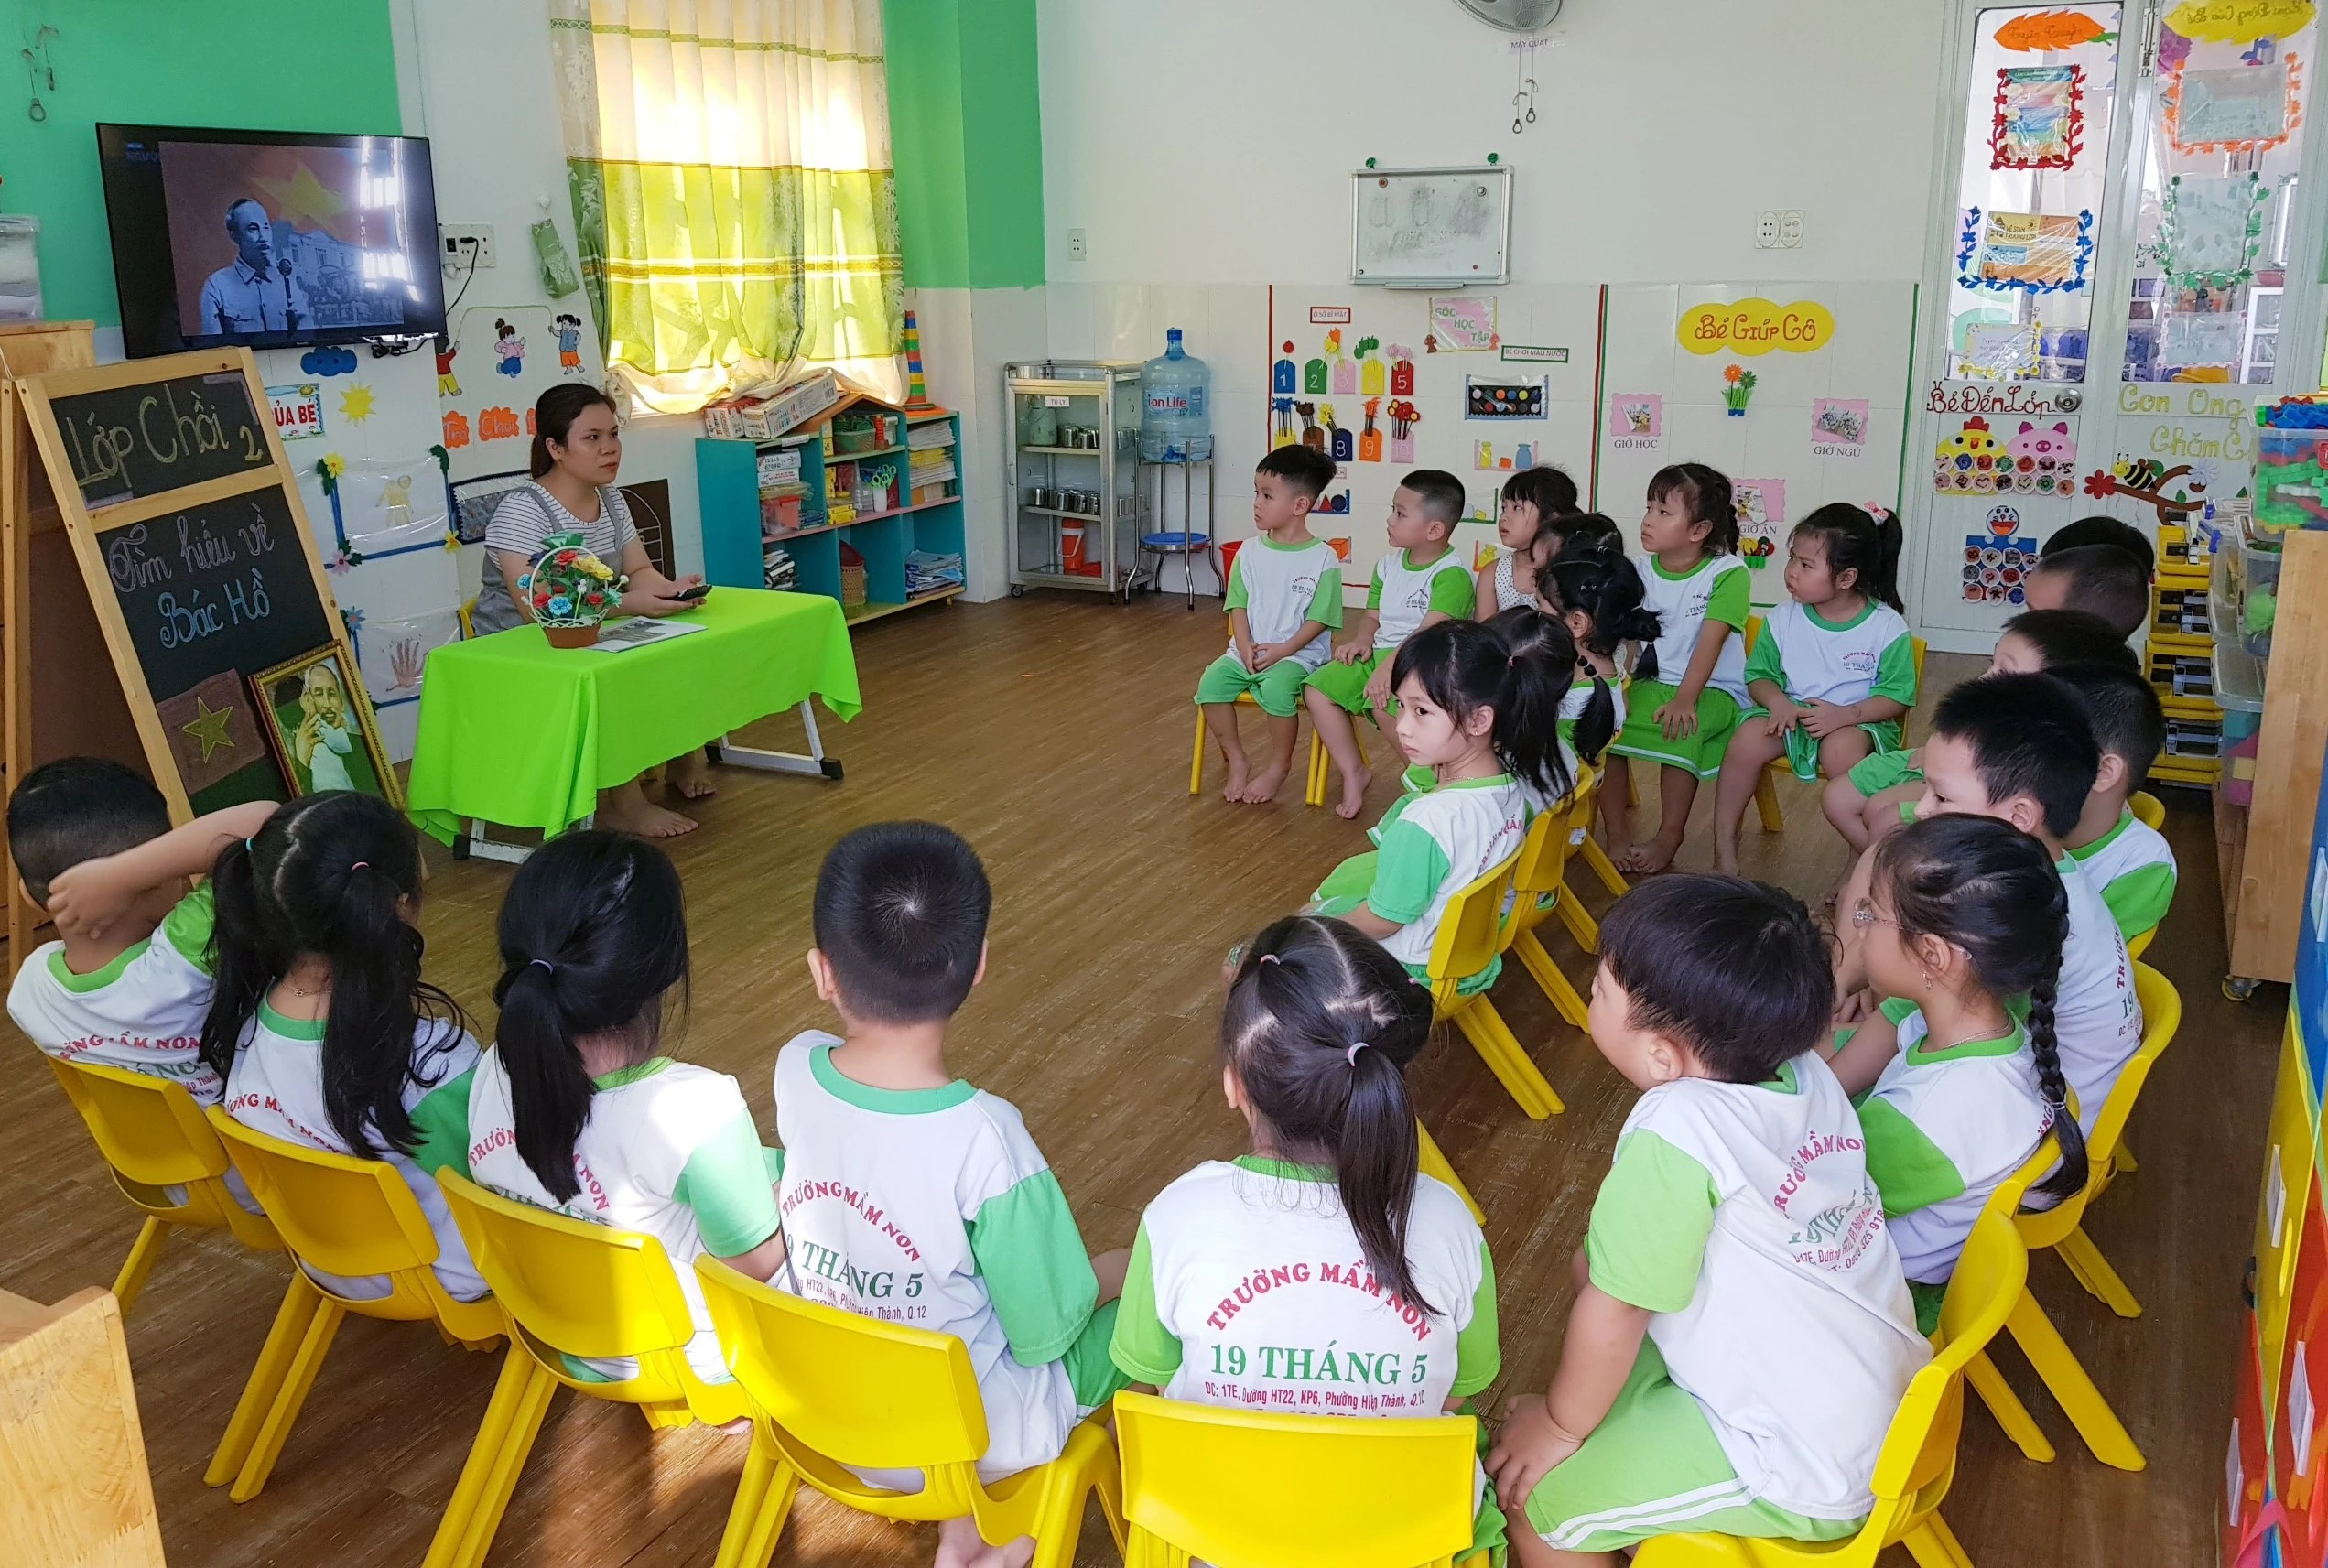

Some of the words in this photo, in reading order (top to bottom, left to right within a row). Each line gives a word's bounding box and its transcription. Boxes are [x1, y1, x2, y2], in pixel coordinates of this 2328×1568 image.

[1695, 314, 1729, 340] Bé
[1280, 374, 1286, 387] 1
[1309, 374, 1318, 388] 2
[1397, 375, 1407, 389] 5
[274, 399, 296, 427] ỦA
[298, 398, 317, 424] BÉ
[1166, 396, 1187, 407] Life
[66, 410, 133, 488] Lớp
[139, 383, 229, 464] Chồi
[239, 425, 264, 461] 2
[1336, 440, 1346, 457] 8
[1365, 441, 1374, 457] 9
[1635, 439, 1658, 449] HỌC
[157, 589, 224, 649] Bác
[222, 567, 270, 625] Hồ
[469, 1127, 517, 1167] TRƯỜN
[1796, 1130, 1834, 1164] MẦM
[579, 1164, 610, 1211] NON
[882, 1221, 920, 1263] NON
[801, 1240, 894, 1299] THÁNG
[905, 1272, 924, 1298] 5
[907, 1305, 926, 1320] Q.12
[1207, 1262, 1311, 1332] TRƯỜNG
[1319, 1259, 1381, 1298] MẦM
[1385, 1291, 1432, 1342] NON
[1211, 1344, 1247, 1376] 19
[1258, 1339, 1402, 1385] THÁNG
[1411, 1353, 1428, 1384] 5
[1205, 1381, 1218, 1399] ĐC:
[1221, 1384, 1240, 1401] 17E,
[1271, 1389, 1297, 1407] HT22,
[1300, 1390, 1321, 1407] KP6,
[1325, 1391, 1359, 1411] Phường
[1381, 1393, 1407, 1409] Thành,
